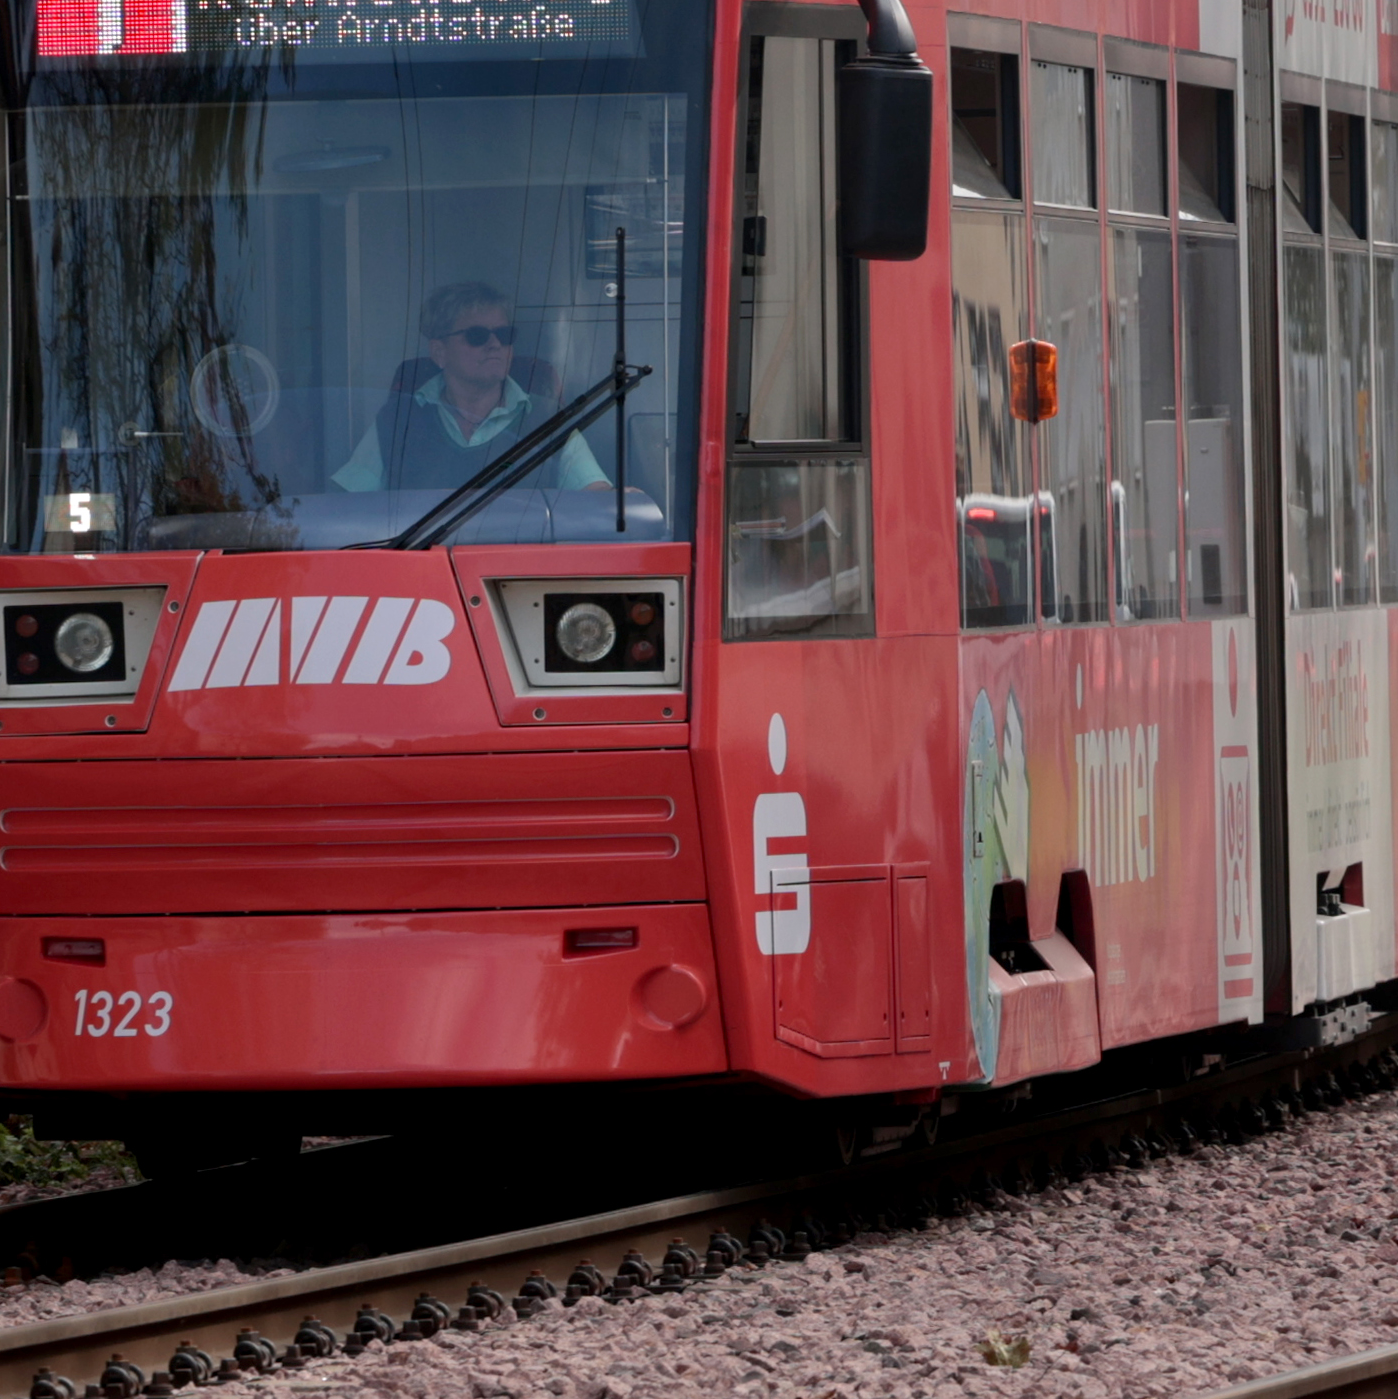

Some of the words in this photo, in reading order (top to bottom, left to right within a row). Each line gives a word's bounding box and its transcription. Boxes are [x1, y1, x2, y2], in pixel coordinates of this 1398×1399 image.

[234, 13, 321, 47] über
[336, 4, 575, 42] Arndtstraße
[69, 493, 91, 532] 5
[1075, 662, 1160, 888] immer
[74, 989, 174, 1038] 1323
